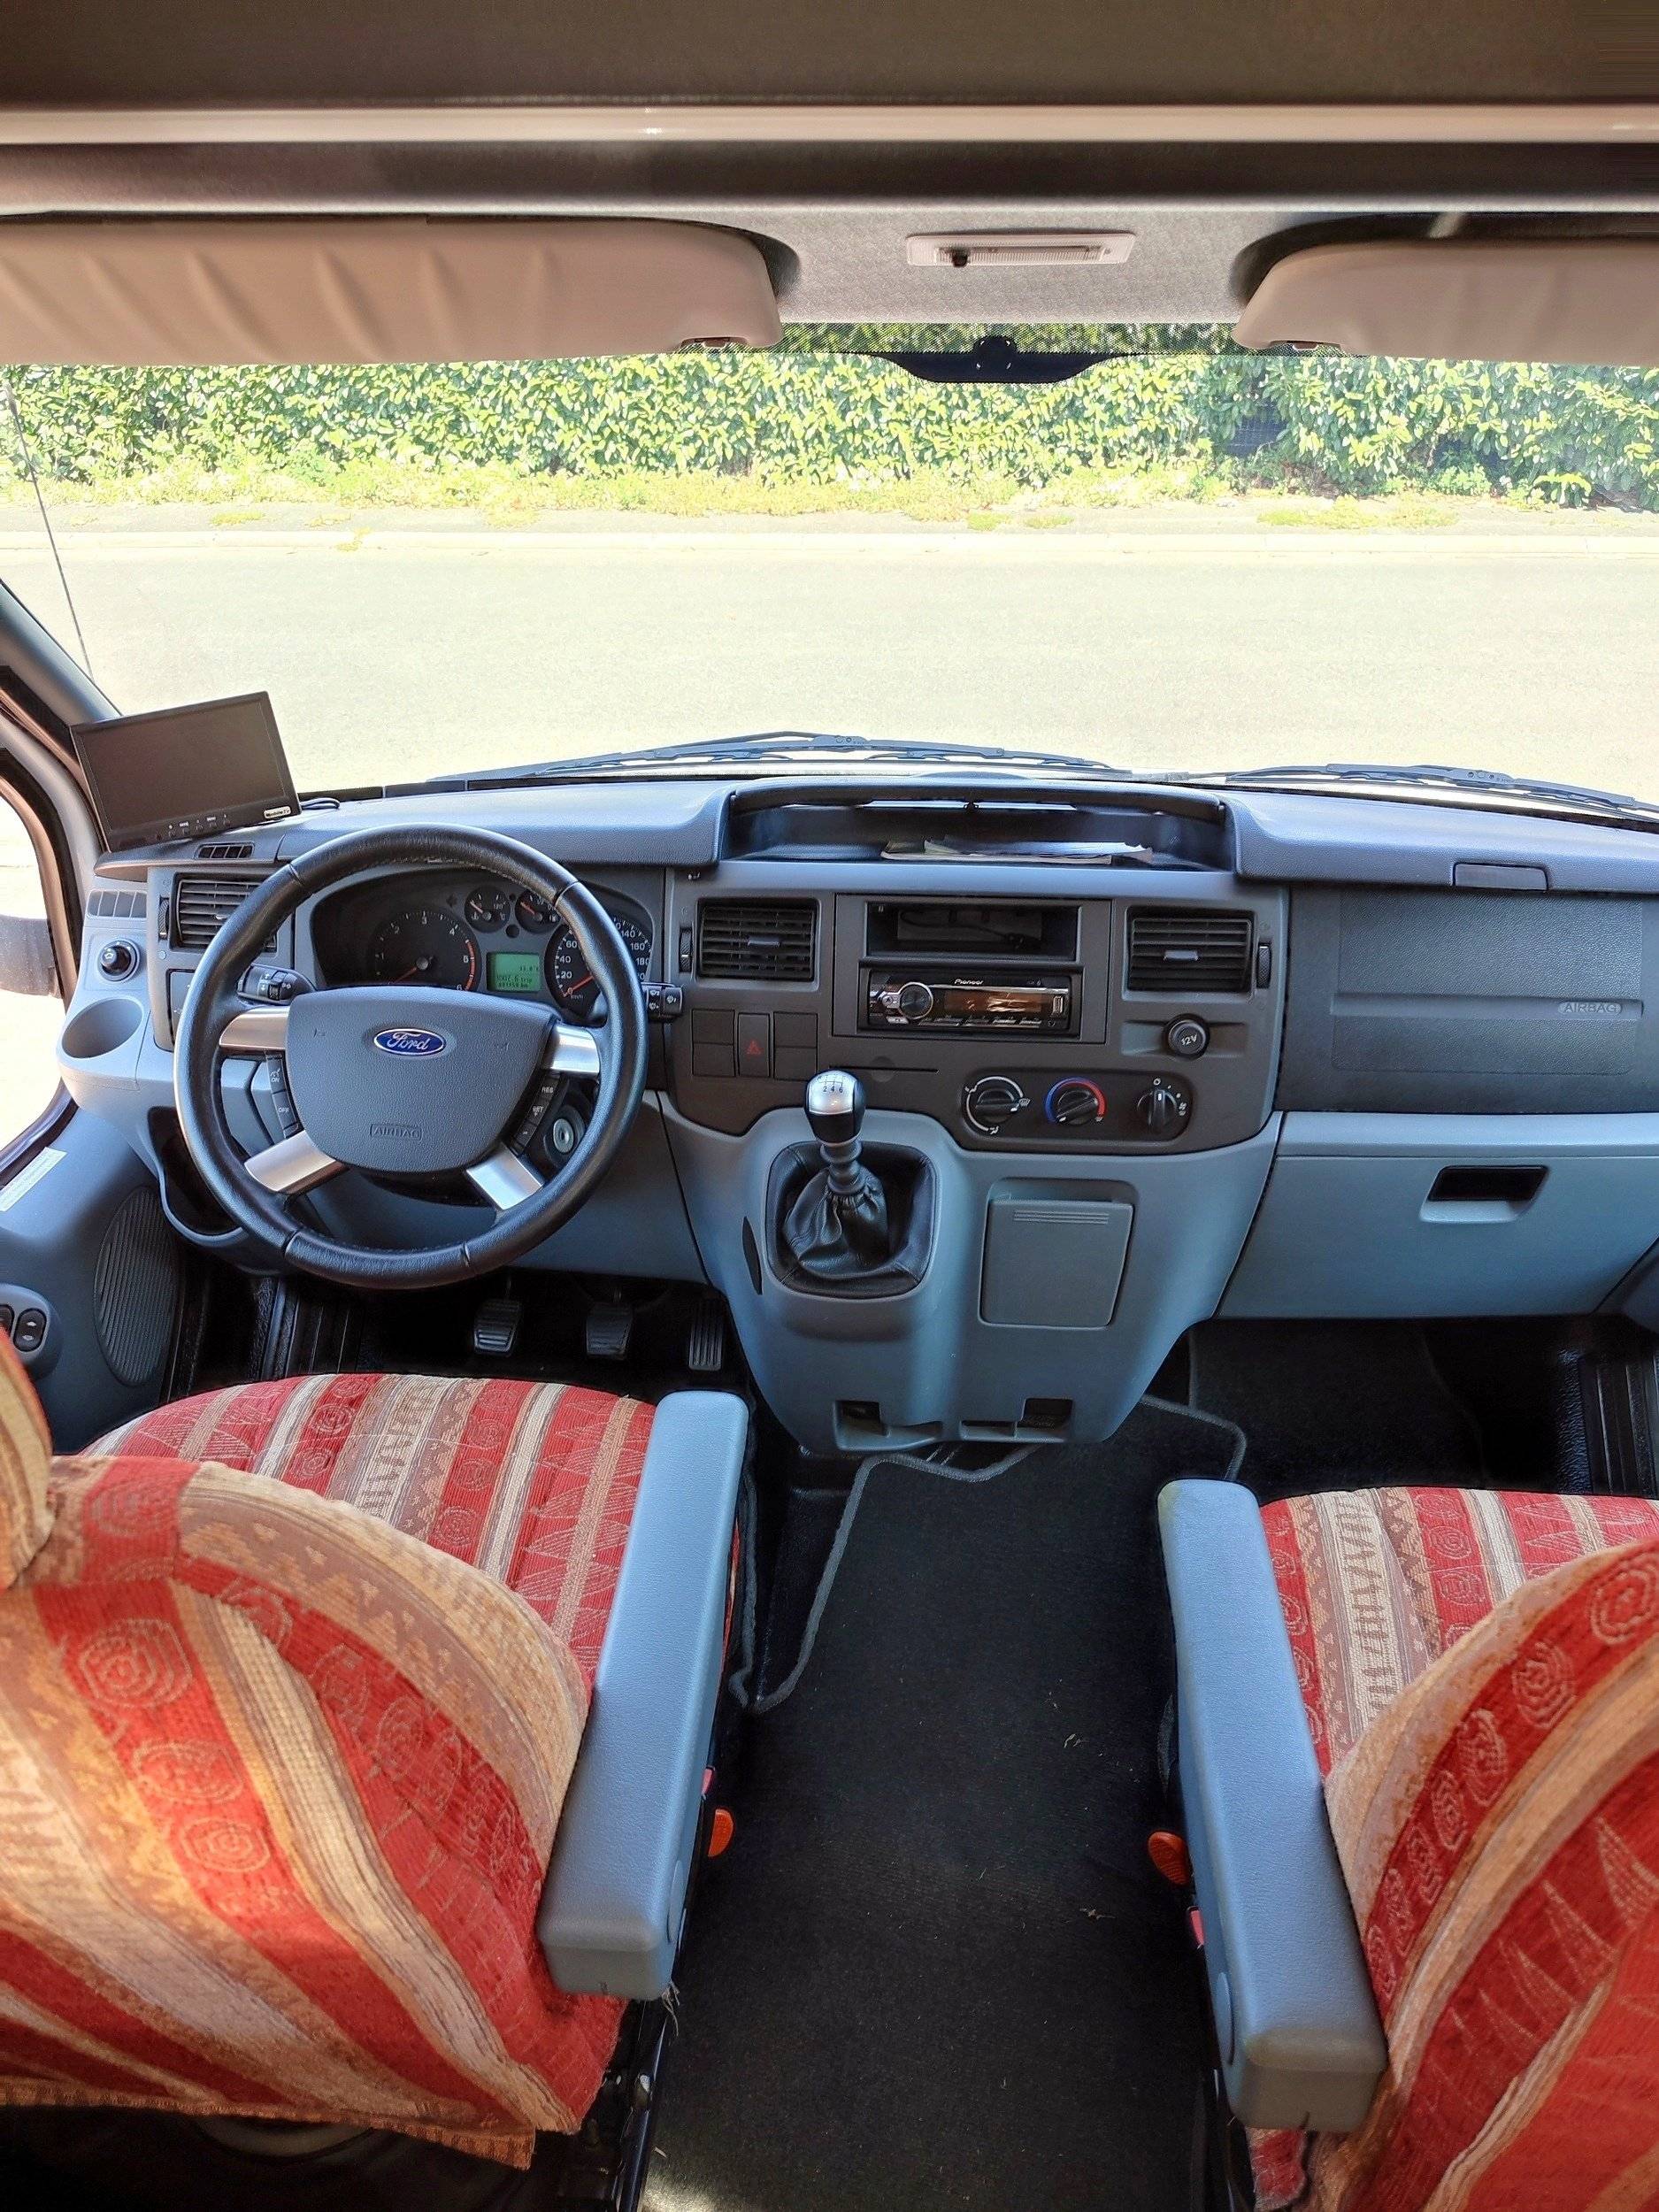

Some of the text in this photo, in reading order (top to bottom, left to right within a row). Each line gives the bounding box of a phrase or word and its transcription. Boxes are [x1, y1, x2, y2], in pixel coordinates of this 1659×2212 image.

[1563, 1002, 1618, 1014] AIRBAG
[387, 1032, 431, 1050] Ford
[1181, 1033, 1198, 1046] 12V
